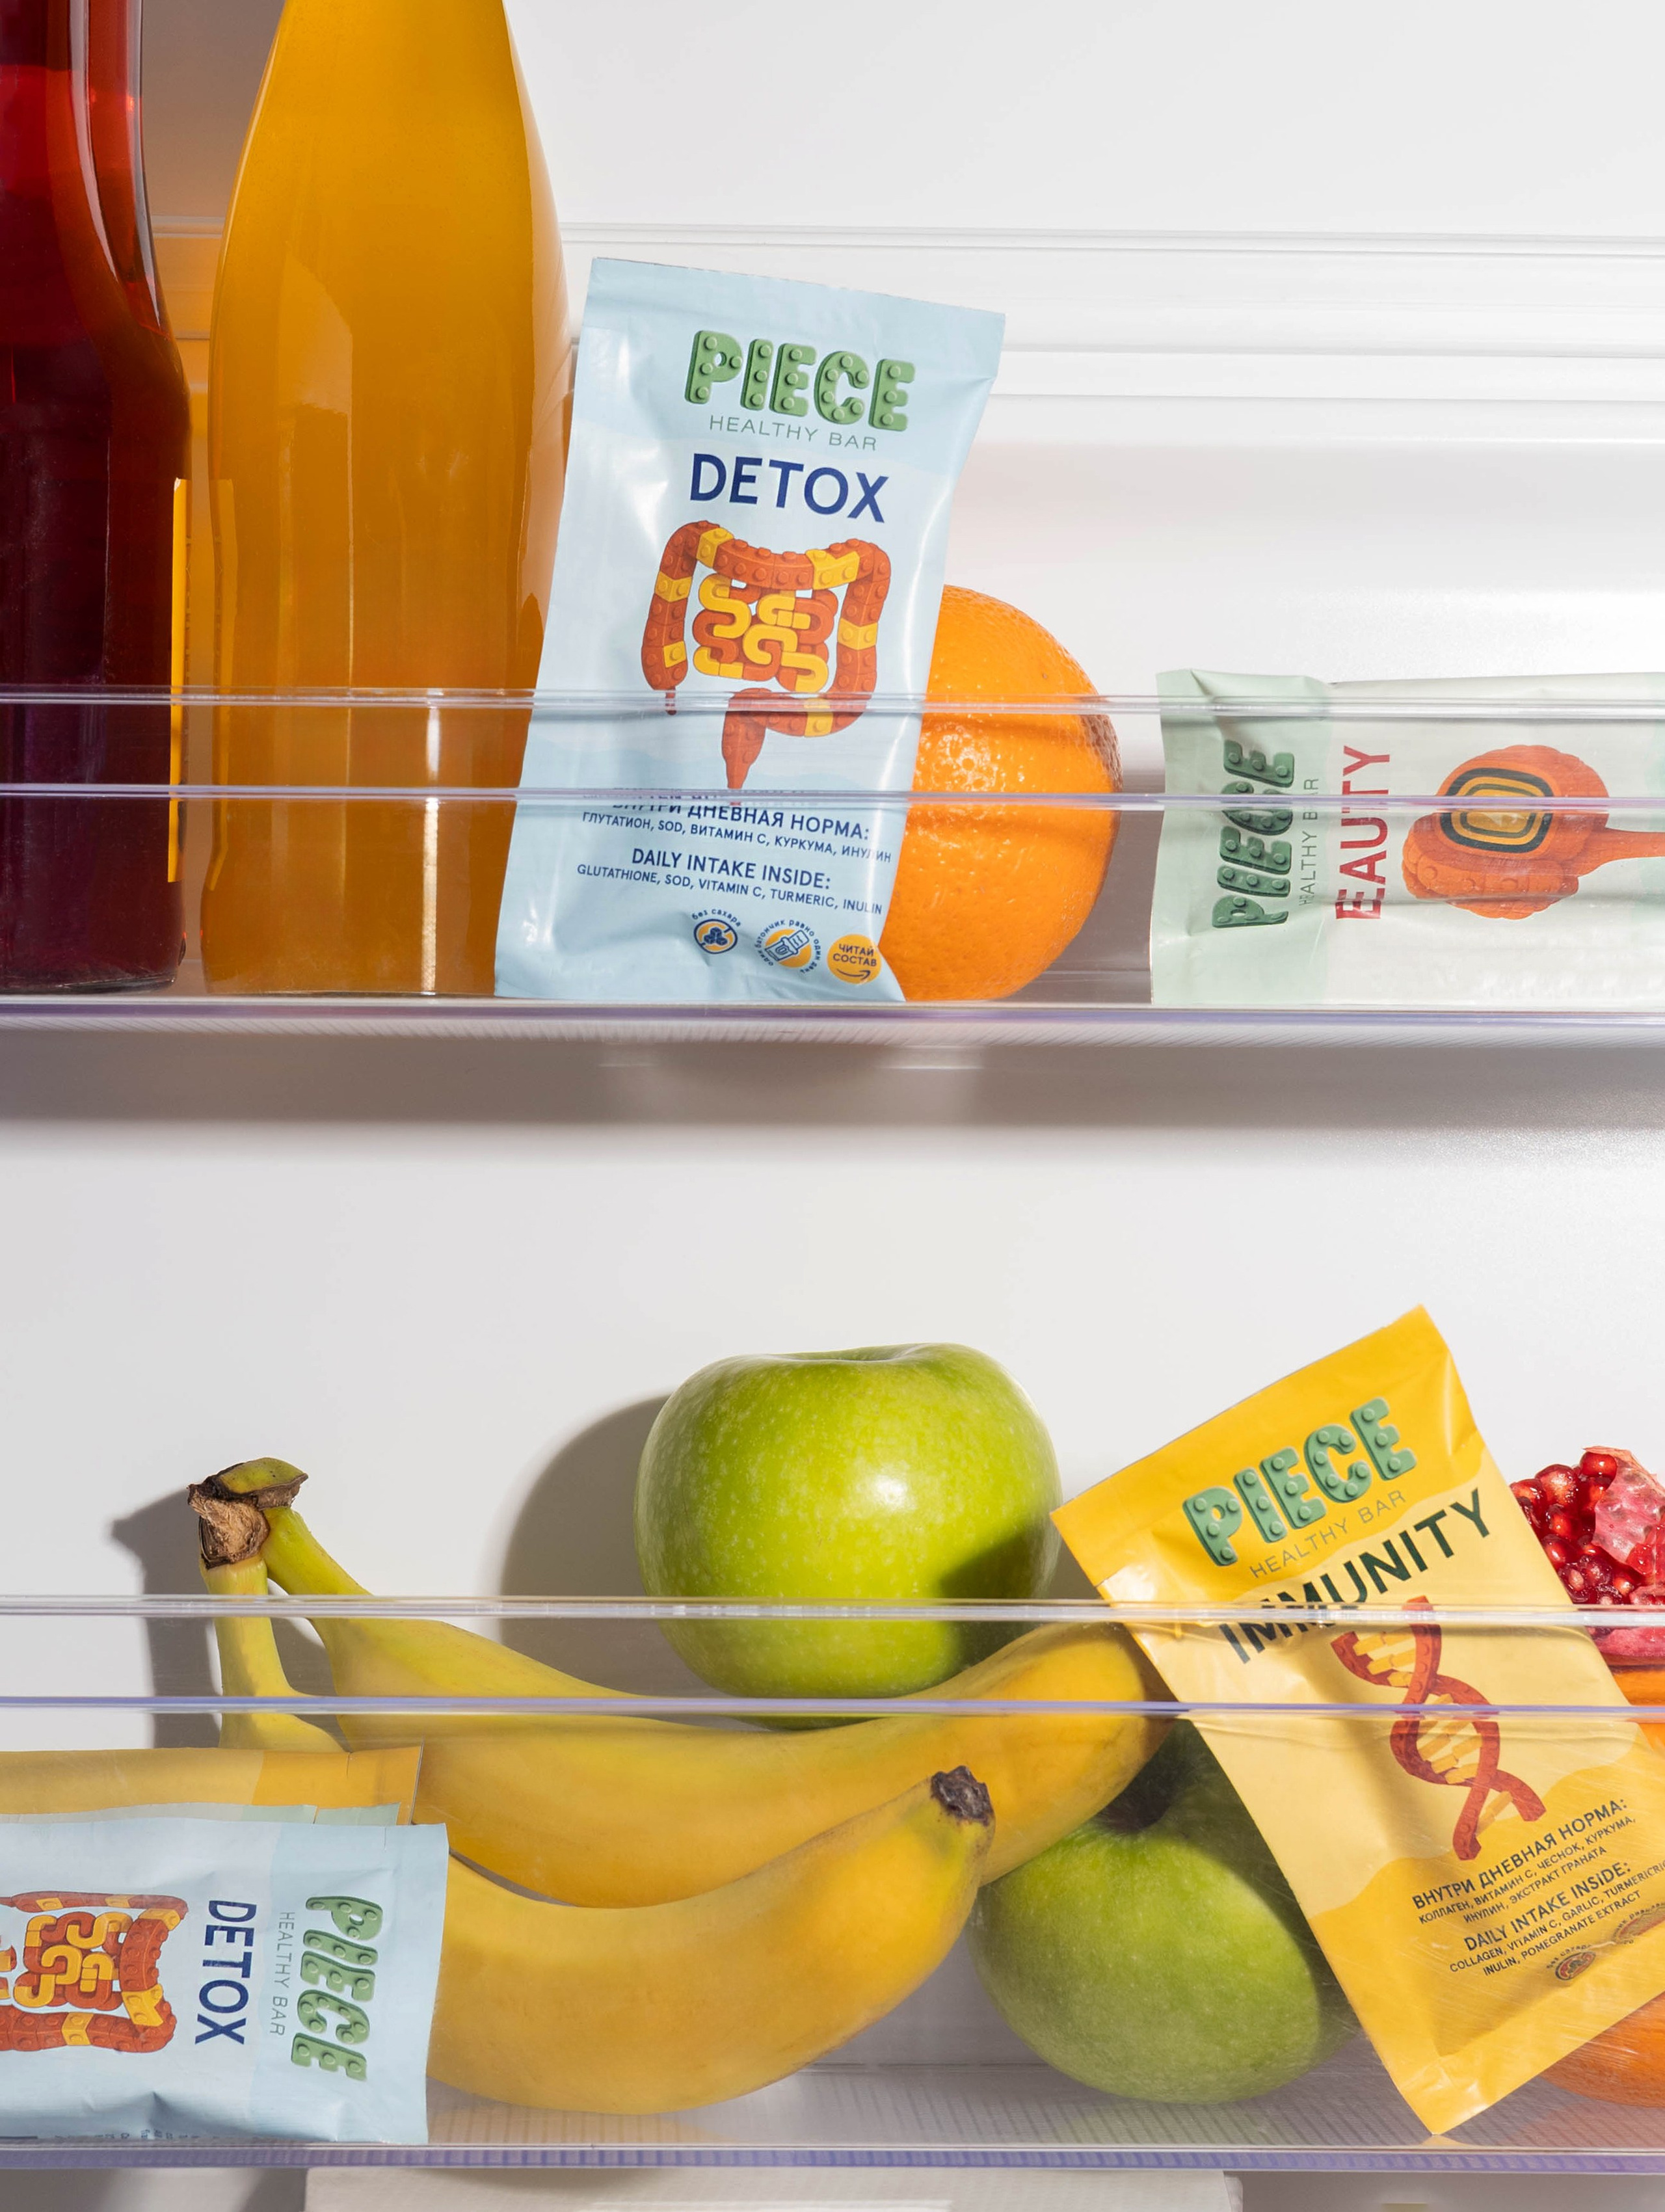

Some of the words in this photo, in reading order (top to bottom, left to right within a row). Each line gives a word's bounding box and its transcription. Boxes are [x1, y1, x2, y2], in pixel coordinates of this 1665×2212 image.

[684, 330, 916, 432] PIECE
[710, 415, 818, 442] HEALTHY
[829, 432, 877, 451] BAR
[690, 453, 889, 523] DETOX
[582, 812, 654, 832] ГЛУТАТИОН,
[658, 820, 686, 834] SOD,
[690, 824, 753, 842] ВИТАМИН
[775, 836, 837, 856] КУРКУМА,
[687, 805, 784, 828] ДНЕВНАЯ
[790, 814, 870, 840] НОРМА:
[1212, 740, 1295, 928] PIECE
[577, 864, 661, 885] GLUTATHIONE,
[665, 874, 694, 890] SOD,
[699, 879, 749, 895] VITAMIN
[753, 886, 766, 899] C,
[770, 888, 838, 909] TURMERIC,
[843, 899, 882, 915] INULIN
[632, 848, 682, 868] DAILY
[687, 855, 756, 879] INTAKE
[762, 865, 831, 889] INSIDE:
[832, 953, 877, 967] СОСТАВ
[838, 943, 874, 957] ЧИТАЙ
[1182, 1396, 1418, 1567] PIECE
[1249, 1517, 1349, 1579] HEALTHY
[1358, 1489, 1405, 1525] BAR
[1219, 1487, 1489, 1664] IMMUNITY
[1412, 1878, 1476, 1910] ВНУТРИ
[1478, 1833, 1557, 1889] ДНЕВНАЯ
[1558, 1799, 1627, 1840] НОРМА:
[1419, 1900, 1474, 1924] КОЛЛАГЕН,
[1474, 1874, 1523, 1905] ВИТАМИН
[1537, 1843, 1584, 1870] ЧЕСНОК,
[1584, 1816, 1636, 1845] КУРКУМА,
[1463, 1902, 1510, 1923] ИНУЛИН,
[1509, 1869, 1560, 1904] ЭКСТРАКТ
[1560, 1846, 1607, 1874] ГРАНАТА
[1450, 1947, 1507, 1973] COLLAGEN,
[1507, 1925, 1548, 1951] VITAMIN
[1562, 1896, 1604, 1921] GARLIC,
[1463, 1925, 1508, 1951] DAILY
[1510, 1891, 1570, 1933] INTAKE
[1570, 1862, 1631, 1899] INSIDE:
[1483, 1957, 1521, 1977] INULIN,
[1521, 1915, 1595, 1960] POMEGRANATE
[1597, 1890, 1640, 1919] EXTRACT
[194, 1899, 257, 2045] DETOX
[274, 1912, 295, 1990] HEALTHY
[291, 1895, 383, 2081] PIECE
[269, 1995, 289, 2036] BAR
